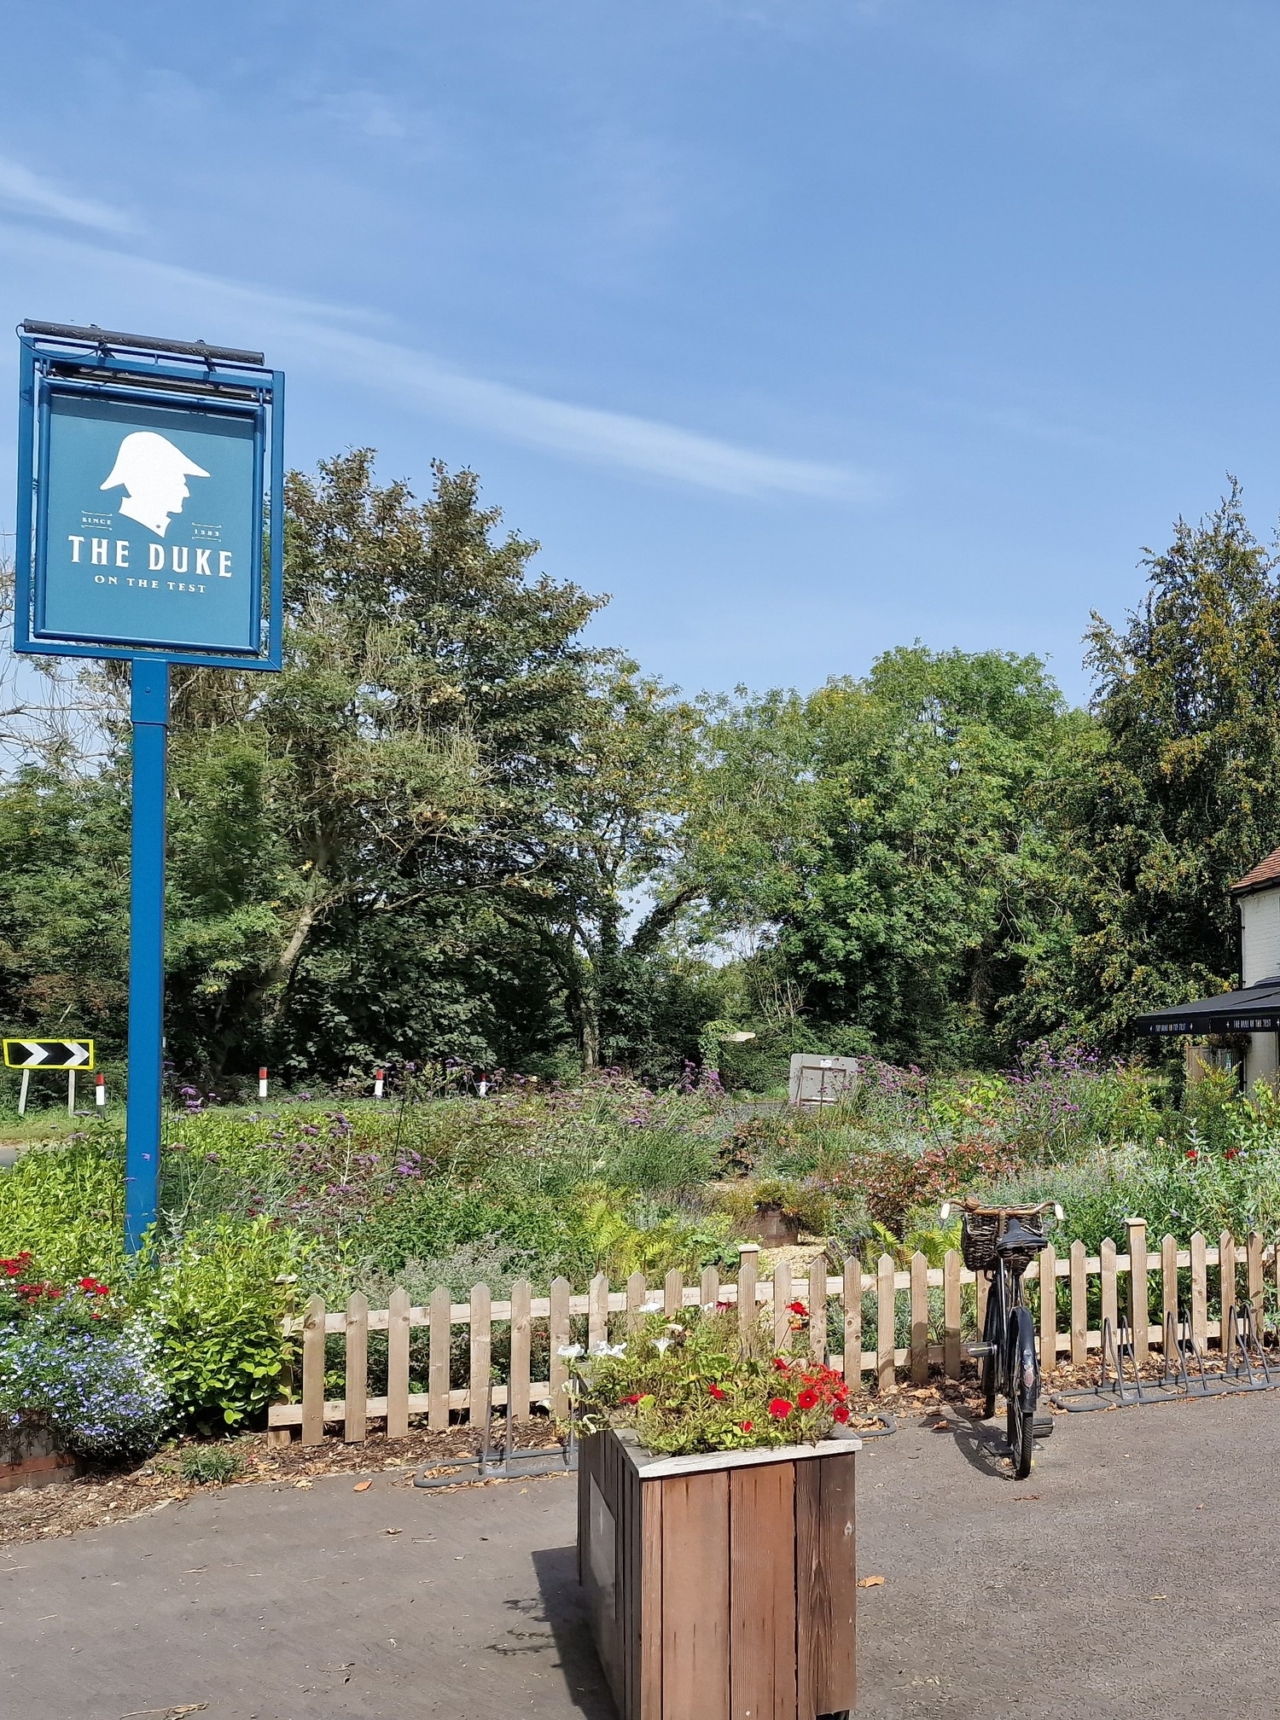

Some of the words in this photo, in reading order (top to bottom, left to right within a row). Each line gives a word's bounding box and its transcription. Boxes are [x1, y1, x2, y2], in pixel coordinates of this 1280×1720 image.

[82, 517, 112, 525] SINCE
[68, 535, 130, 568] THE
[148, 543, 232, 578] DUKE
[94, 575, 118, 585] ON
[127, 577, 159, 589] THE
[167, 581, 207, 594] TEST
